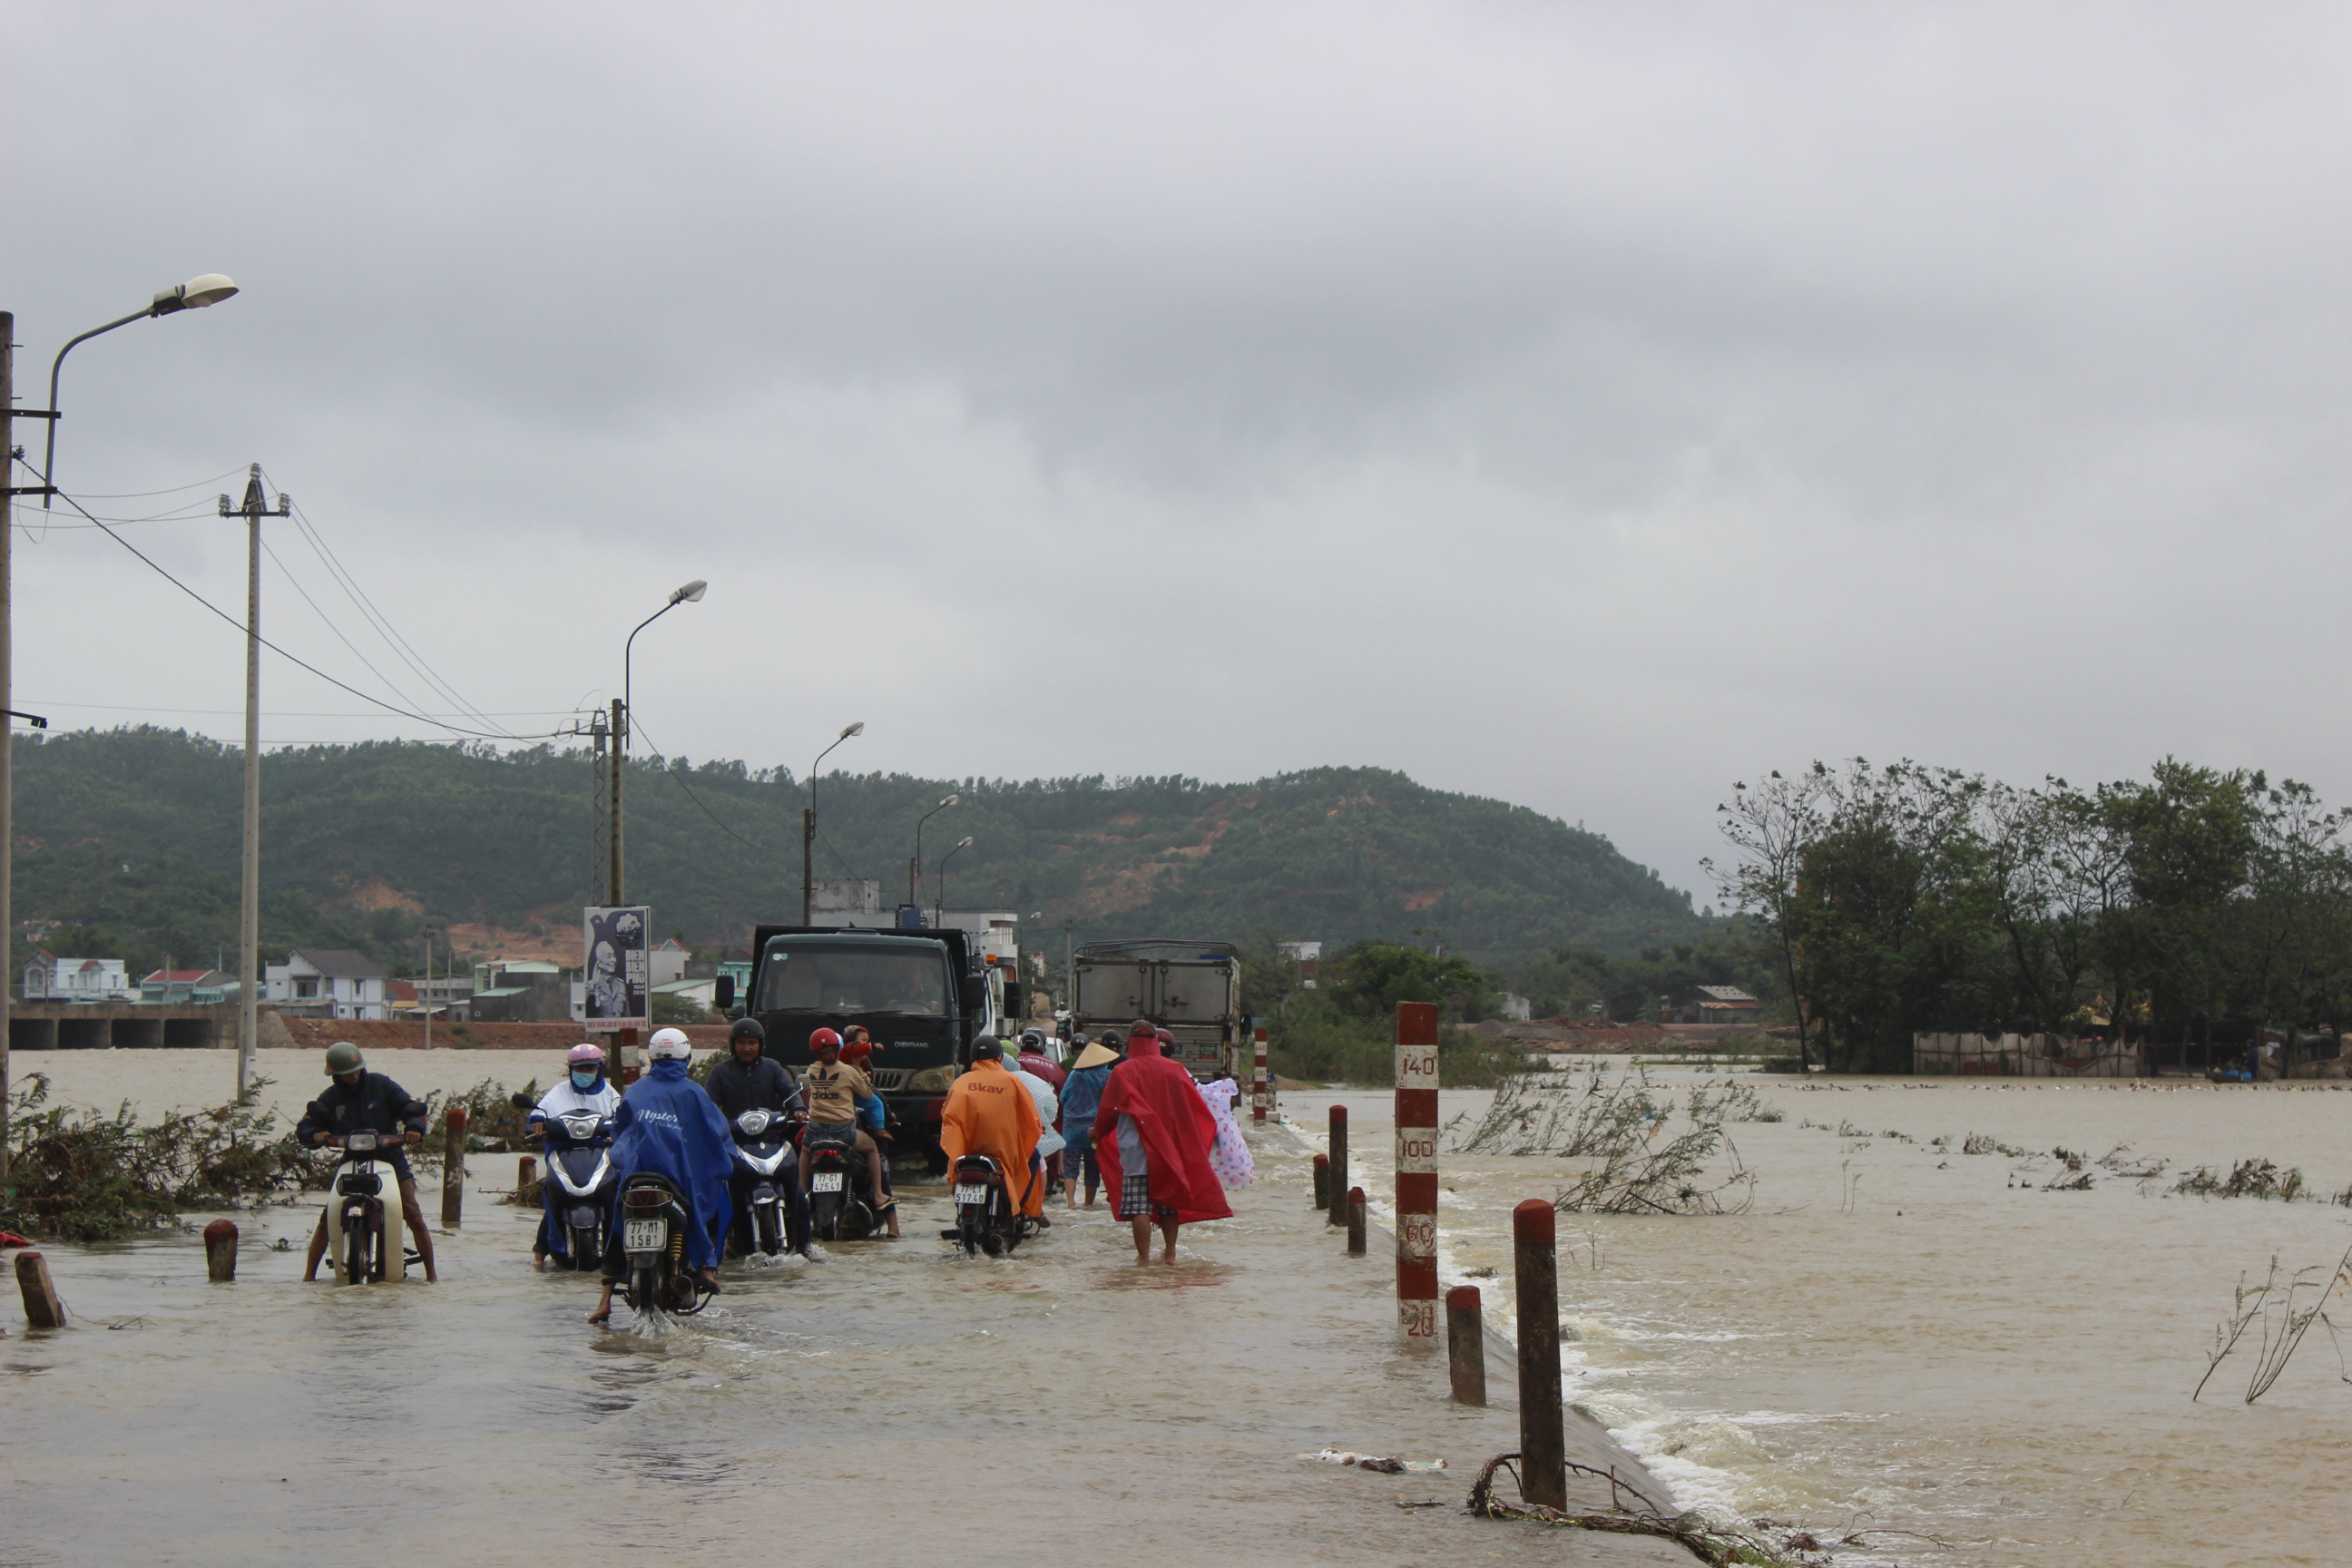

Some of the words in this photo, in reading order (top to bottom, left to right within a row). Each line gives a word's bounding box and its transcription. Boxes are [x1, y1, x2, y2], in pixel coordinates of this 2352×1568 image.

[1403, 1056, 1434, 1075] 140
[968, 1083, 1004, 1094] Bkav
[813, 1090, 840, 1100] adidas
[1403, 1140, 1434, 1158] 100
[818, 1174, 838, 1182] 77-G1
[960, 1184, 982, 1193] 77-L1
[956, 1193, 984, 1202] 517.40
[631, 1221, 658, 1234] 77-M1
[631, 1234, 657, 1247] 1581
